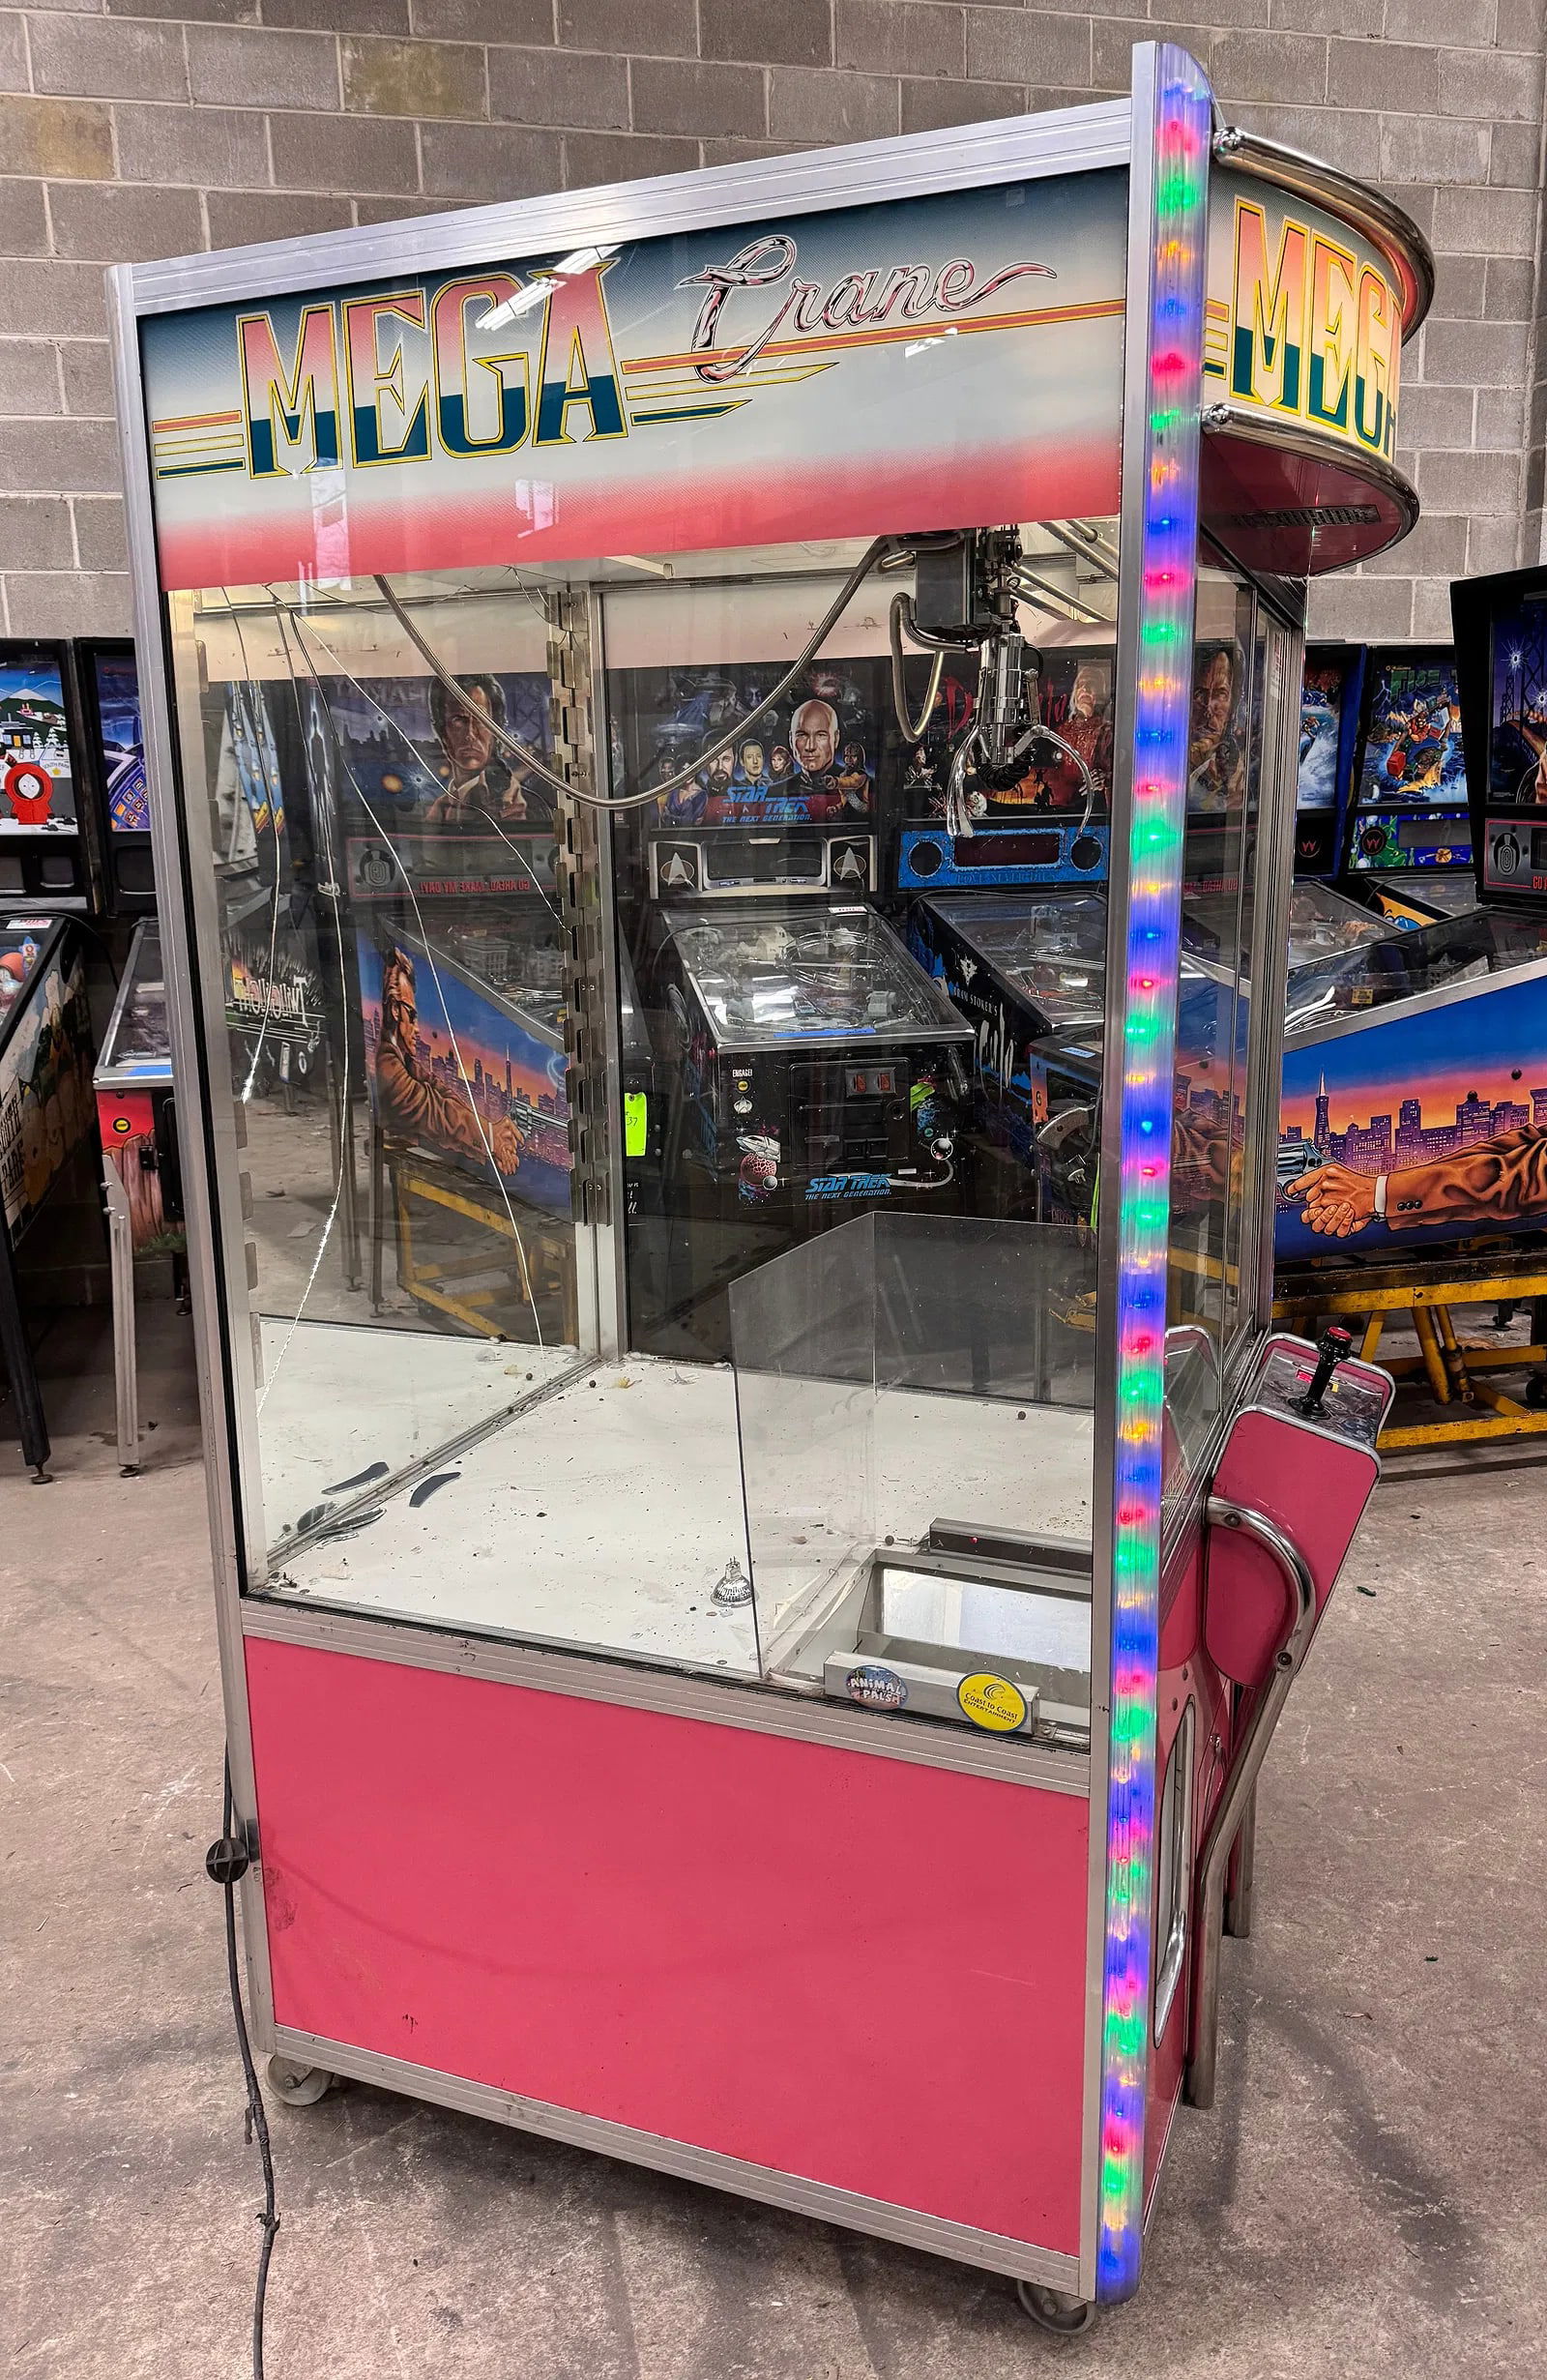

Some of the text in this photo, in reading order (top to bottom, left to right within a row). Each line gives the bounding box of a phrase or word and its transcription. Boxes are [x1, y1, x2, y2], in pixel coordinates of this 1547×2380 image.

[1229, 194, 1402, 460] MEG
[235, 234, 1057, 481] MEGA Crane
[722, 785, 769, 804] STAR
[765, 796, 810, 813] TREK
[805, 1173, 894, 1193] STAR TREK
[963, 1698, 1016, 1724] ENTERTAINMENT
[965, 1692, 986, 1706] Coast
[997, 1705, 1018, 1719] Coast
